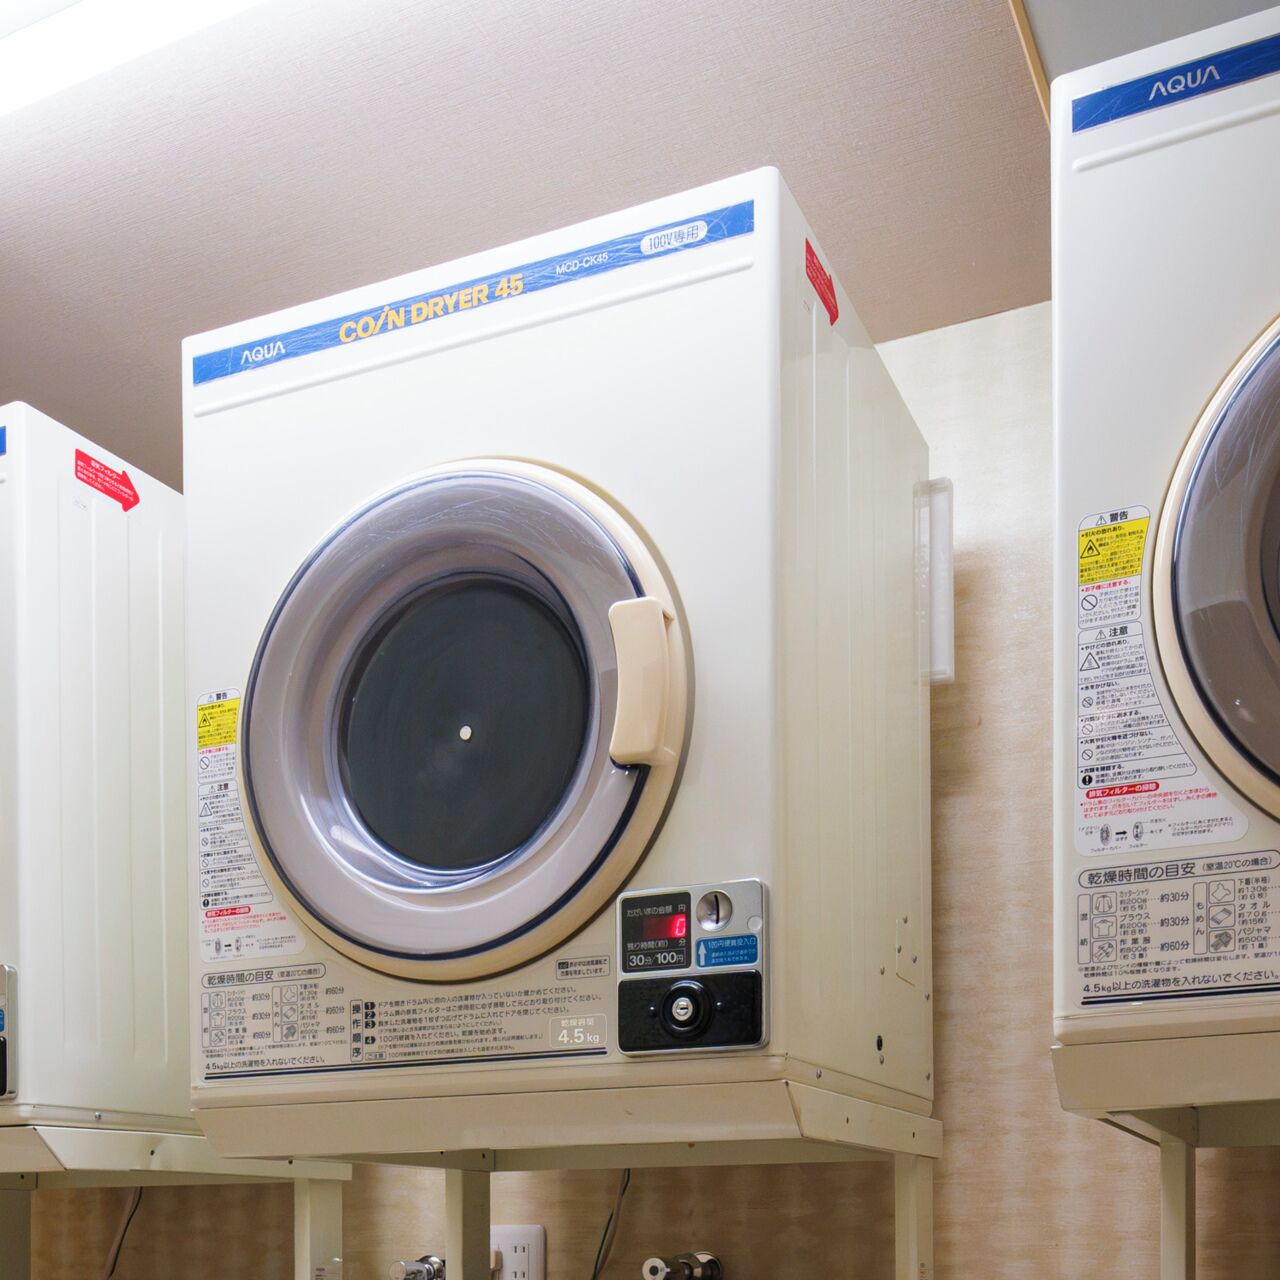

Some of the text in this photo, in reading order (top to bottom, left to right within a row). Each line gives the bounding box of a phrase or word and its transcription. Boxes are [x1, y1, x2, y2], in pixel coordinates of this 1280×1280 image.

[1148, 65, 1220, 101] AQUA
[240, 341, 286, 365] AQUA
[411, 283, 489, 324] DRYER
[495, 273, 524, 298] 45
[555, 252, 609, 276] MCD-CK45
[1109, 625, 1128, 637] 注意
[1088, 862, 1195, 886] 乾燥時間の目安
[1238, 901, 1271, 911] タオル
[1120, 912, 1151, 922] ブラウス
[1195, 901, 1205, 936] もめん
[1238, 926, 1272, 936] パジャマ
[1083, 970, 1280, 993] 4.5kg以上の洗濯物を入れないでください。
[558, 1028, 584, 1044] 4.5
[586, 1032, 600, 1044] kg
